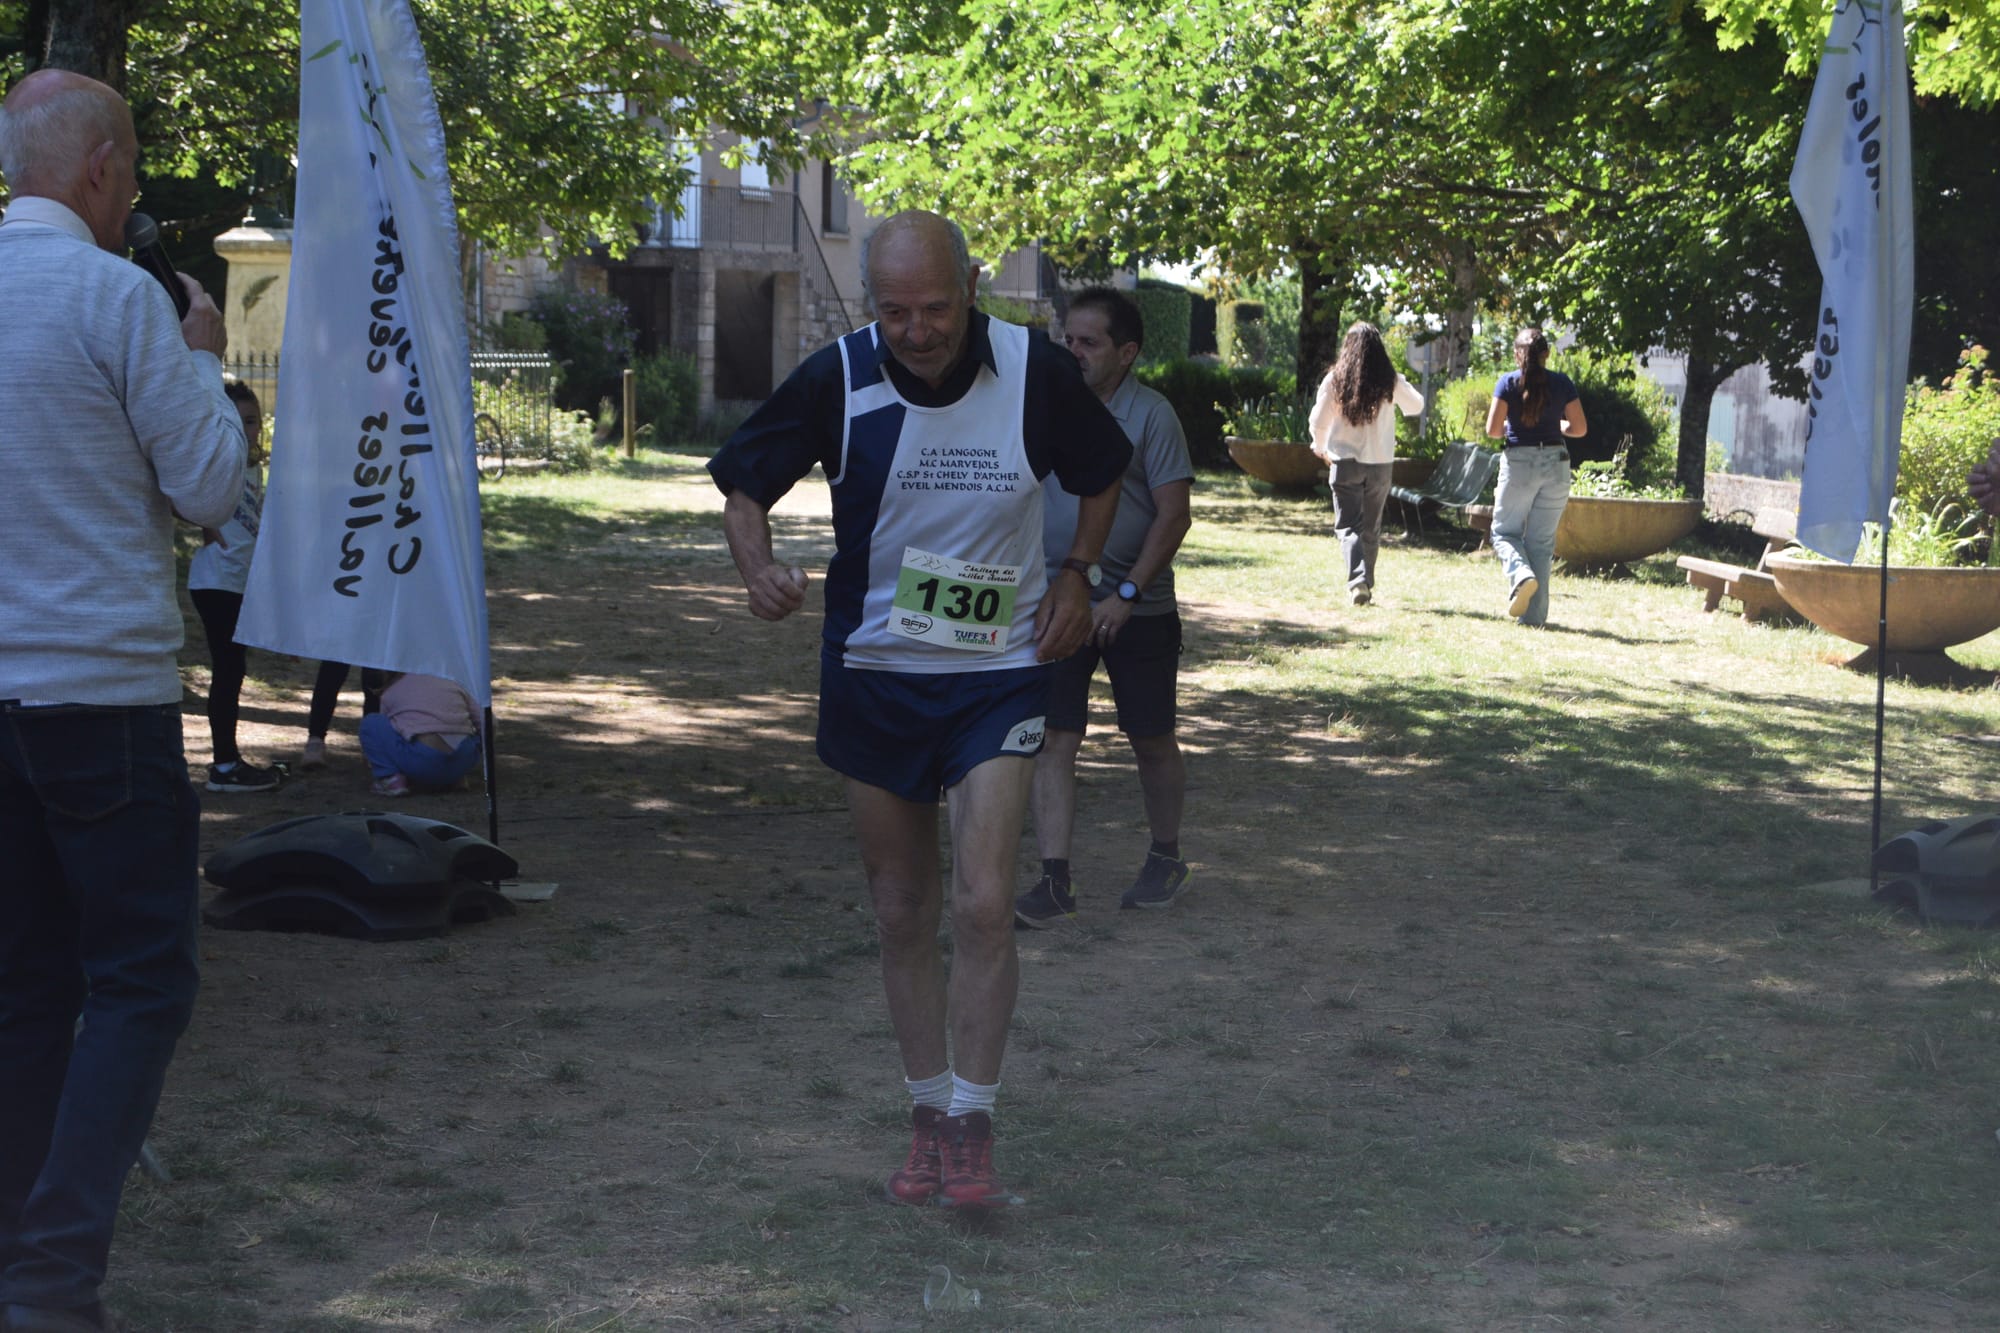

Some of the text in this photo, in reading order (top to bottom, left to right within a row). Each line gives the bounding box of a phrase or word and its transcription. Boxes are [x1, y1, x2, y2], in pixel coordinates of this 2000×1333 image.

[942, 448, 997, 458] LANGOGNE
[940, 459, 999, 470] MARVEJOLS
[936, 470, 968, 479] CHELY
[974, 471, 1020, 481] D'APCHER
[901, 481, 1017, 493] EVEIL MENDOIS A.C.M.
[917, 577, 1000, 622] 130
[900, 617, 928, 629] BFP
